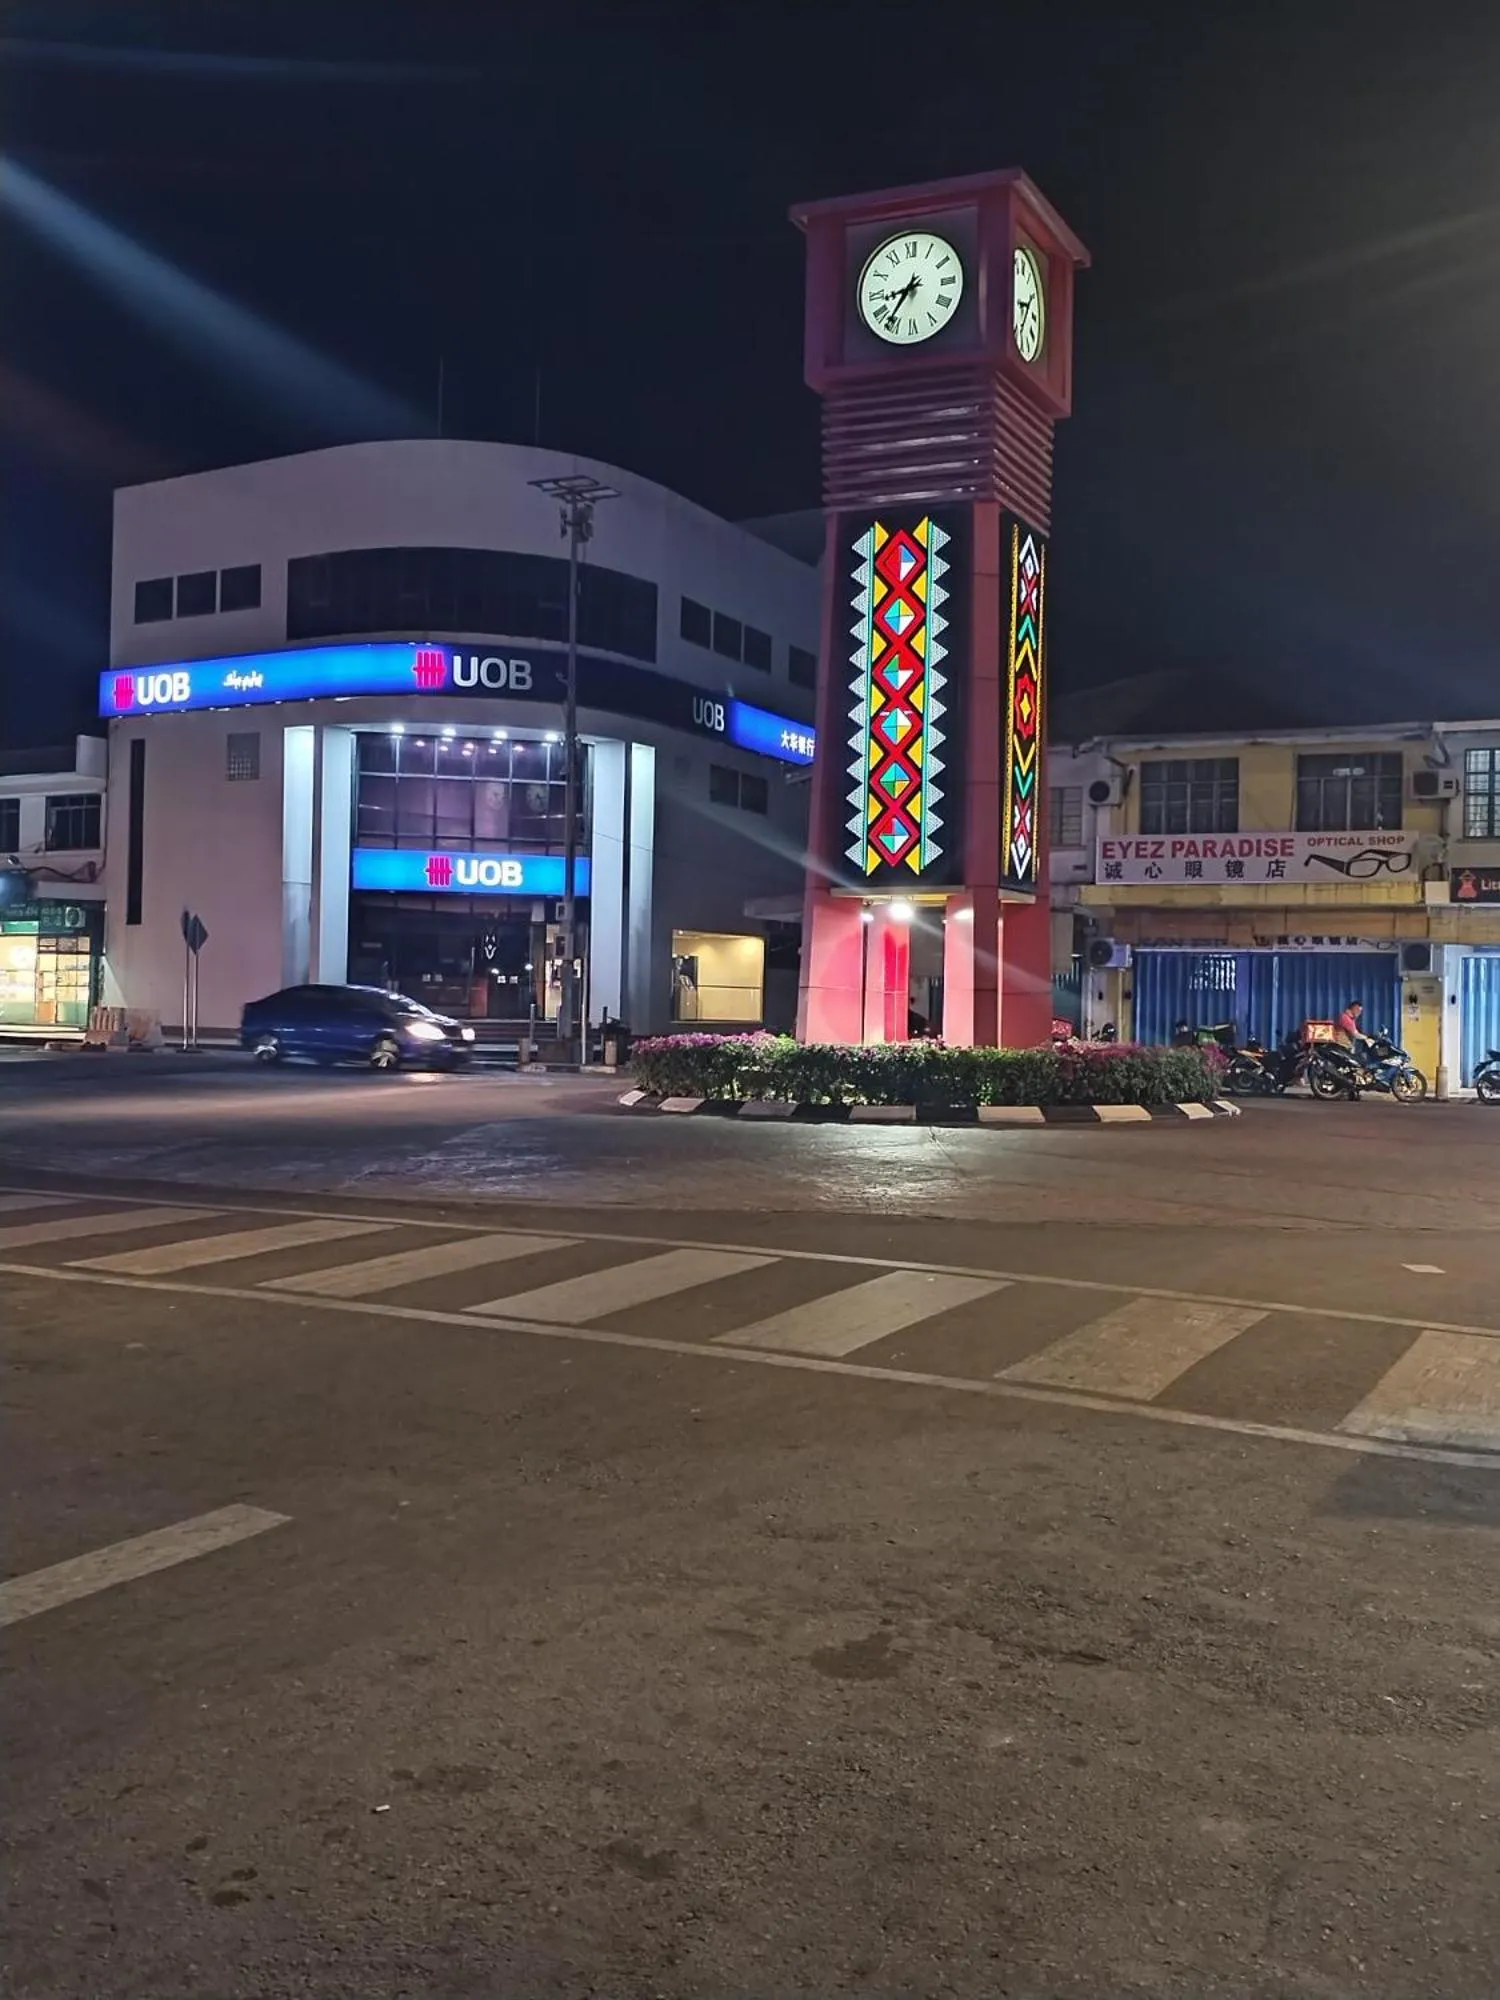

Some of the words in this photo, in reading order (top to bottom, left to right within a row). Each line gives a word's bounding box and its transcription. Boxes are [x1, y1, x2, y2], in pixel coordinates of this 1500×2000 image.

[453, 655, 533, 690] UOB
[136, 671, 190, 705] UOB
[692, 696, 725, 732] UOB
[1102, 841, 1165, 859] EYEZ
[1171, 838, 1294, 858] PARADISE
[1306, 836, 1364, 847] OPTICAL
[1368, 835, 1405, 846] SHOP
[456, 858, 524, 887] UOB
[1480, 878, 1500, 891] Lit
